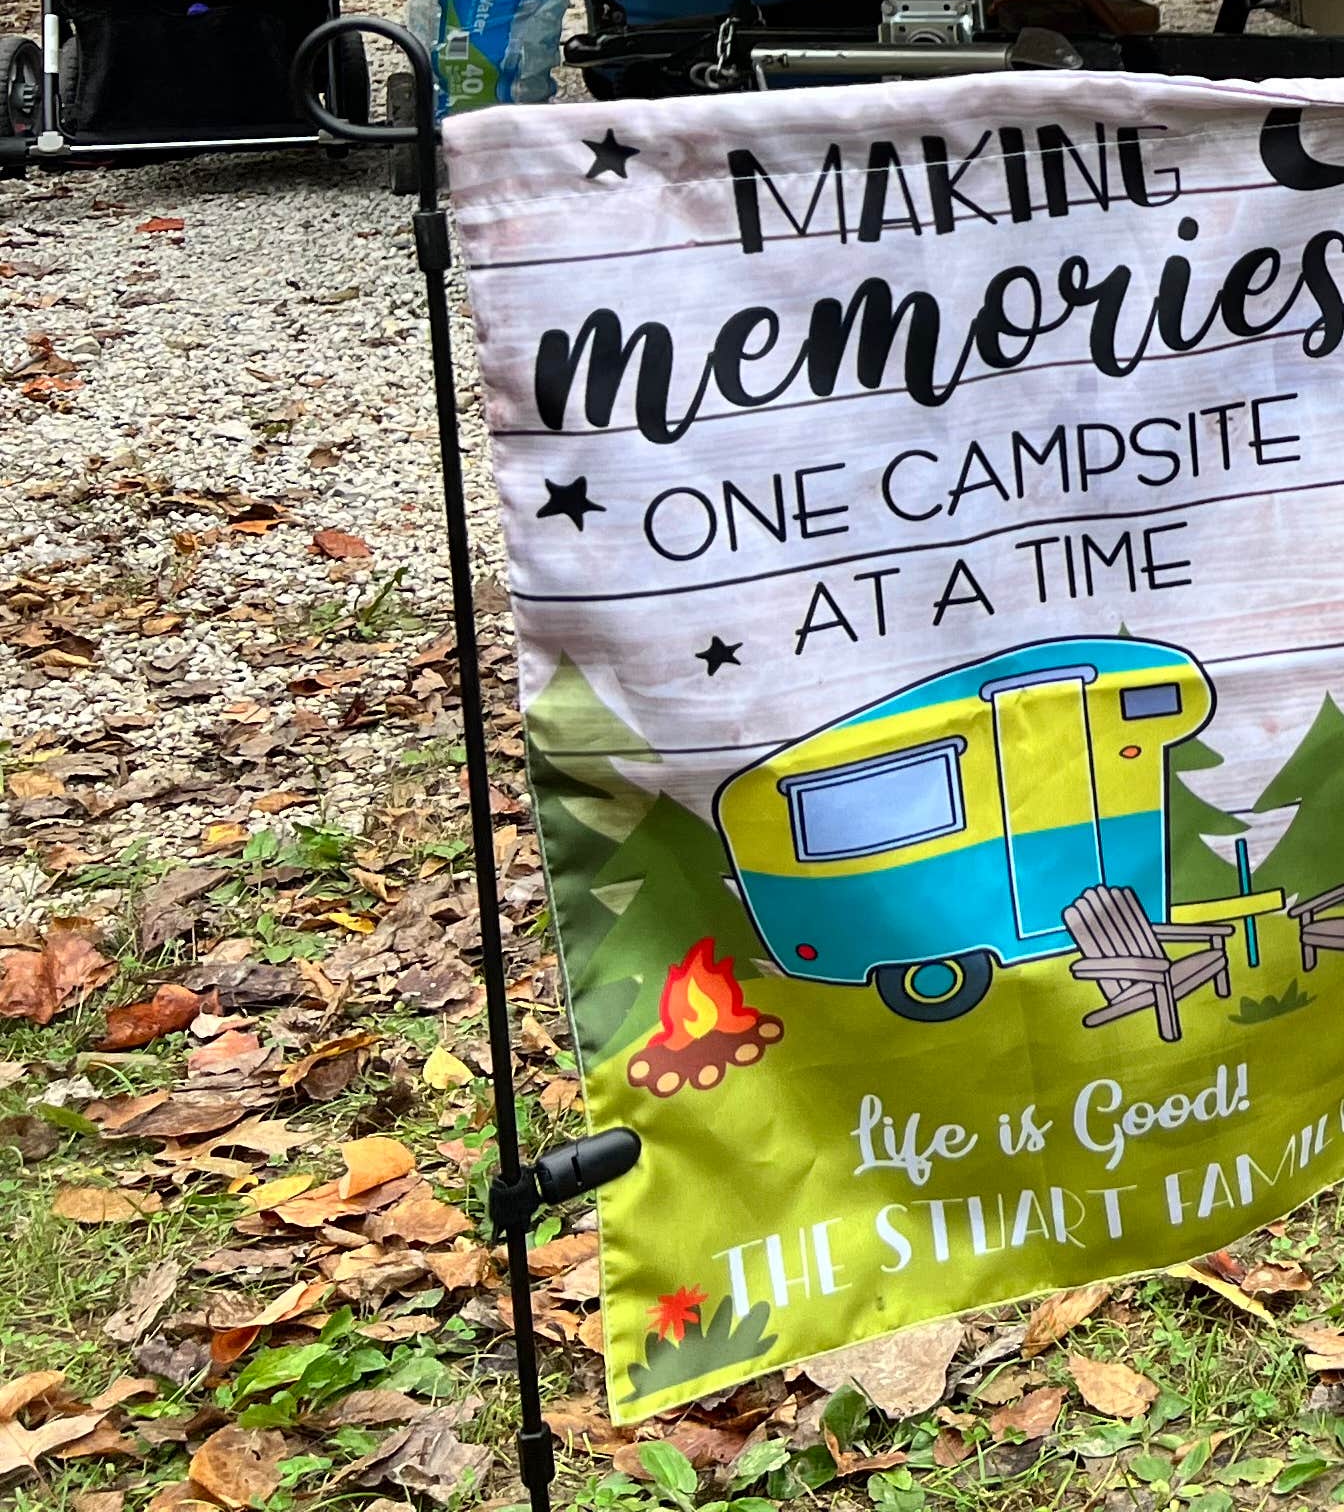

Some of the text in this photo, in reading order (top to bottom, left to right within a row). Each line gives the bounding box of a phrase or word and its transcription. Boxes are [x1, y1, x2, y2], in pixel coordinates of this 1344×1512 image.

[460, 63, 484, 94] 40
[728, 122, 1182, 254] MAKING
[642, 392, 1302, 562] ONE CAMPSITE
[794, 521, 1194, 656] AT A TIME
[850, 1062, 1252, 1185] Life is Good!
[710, 1214, 853, 1320] THE
[874, 1182, 1138, 1274] STUART
